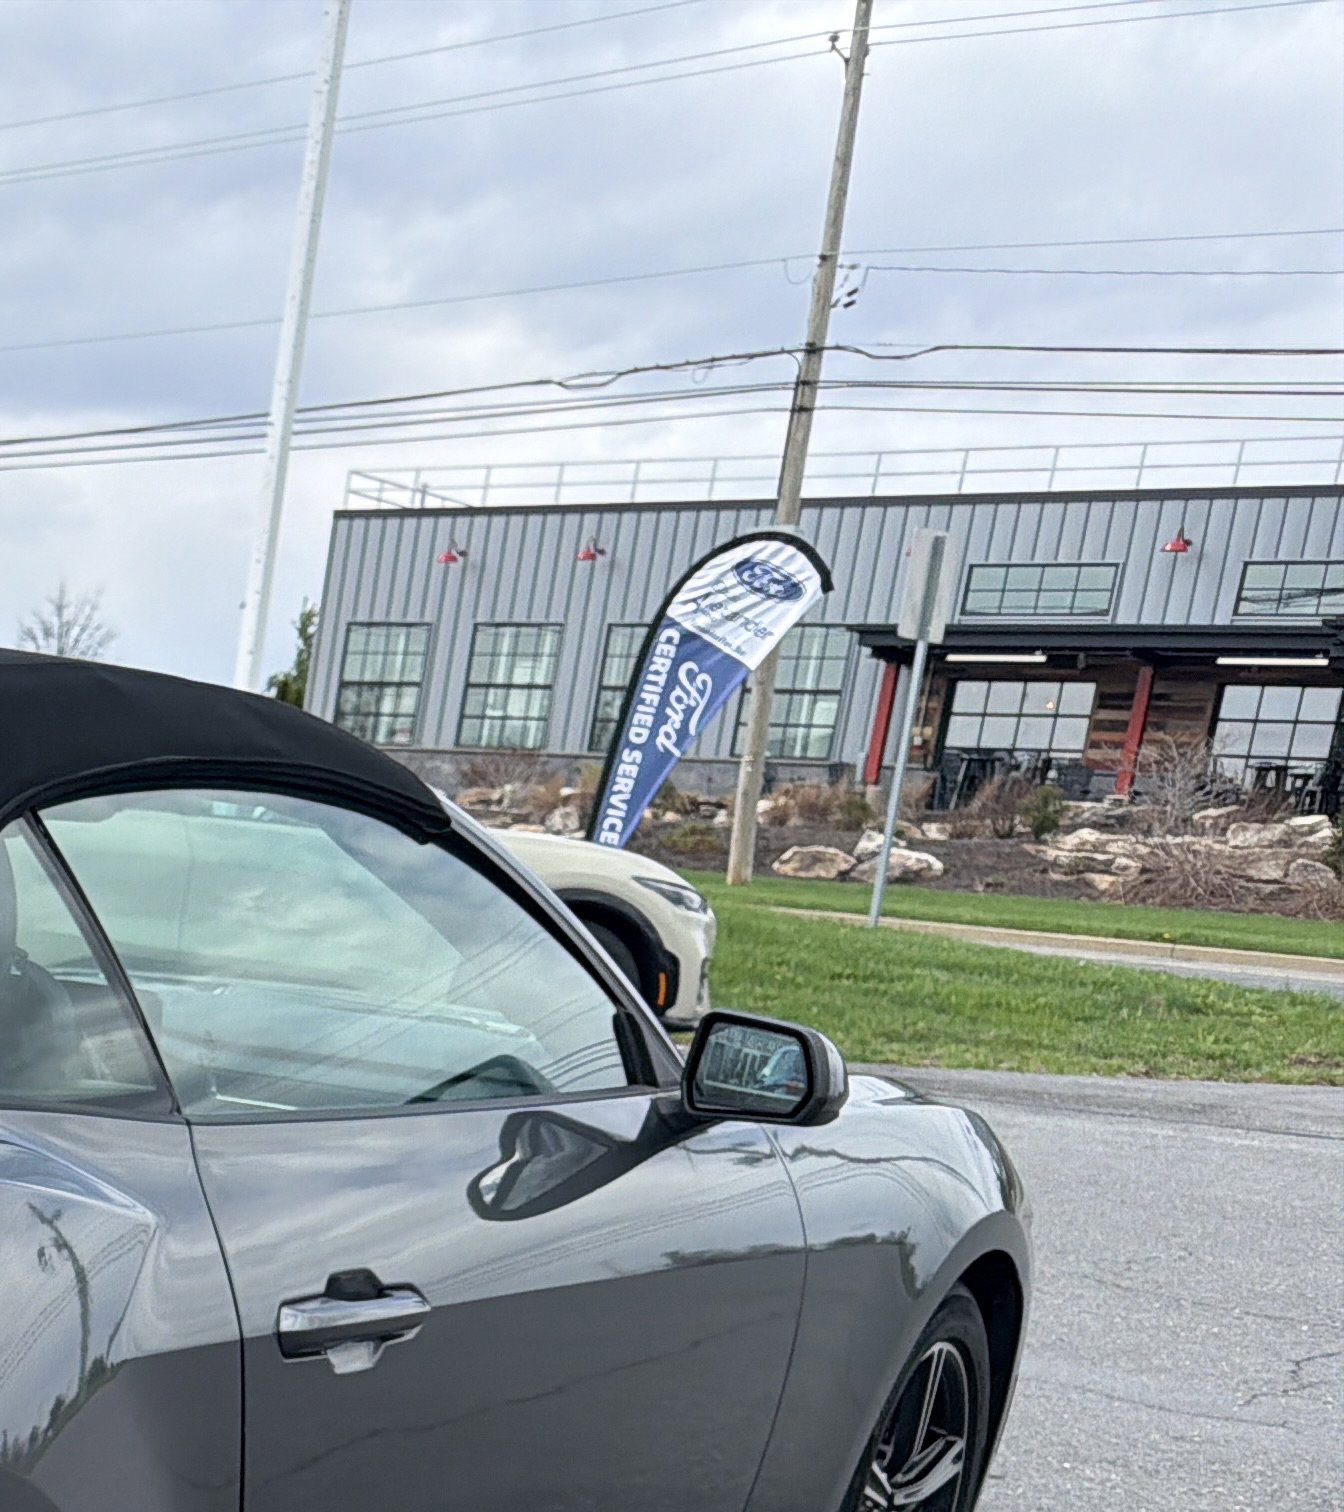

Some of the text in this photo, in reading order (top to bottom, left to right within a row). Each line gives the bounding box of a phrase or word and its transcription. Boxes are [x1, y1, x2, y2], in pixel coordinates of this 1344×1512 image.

[599, 628, 680, 847] CERTIFIED SERVICE
[656, 660, 713, 758] Ford
